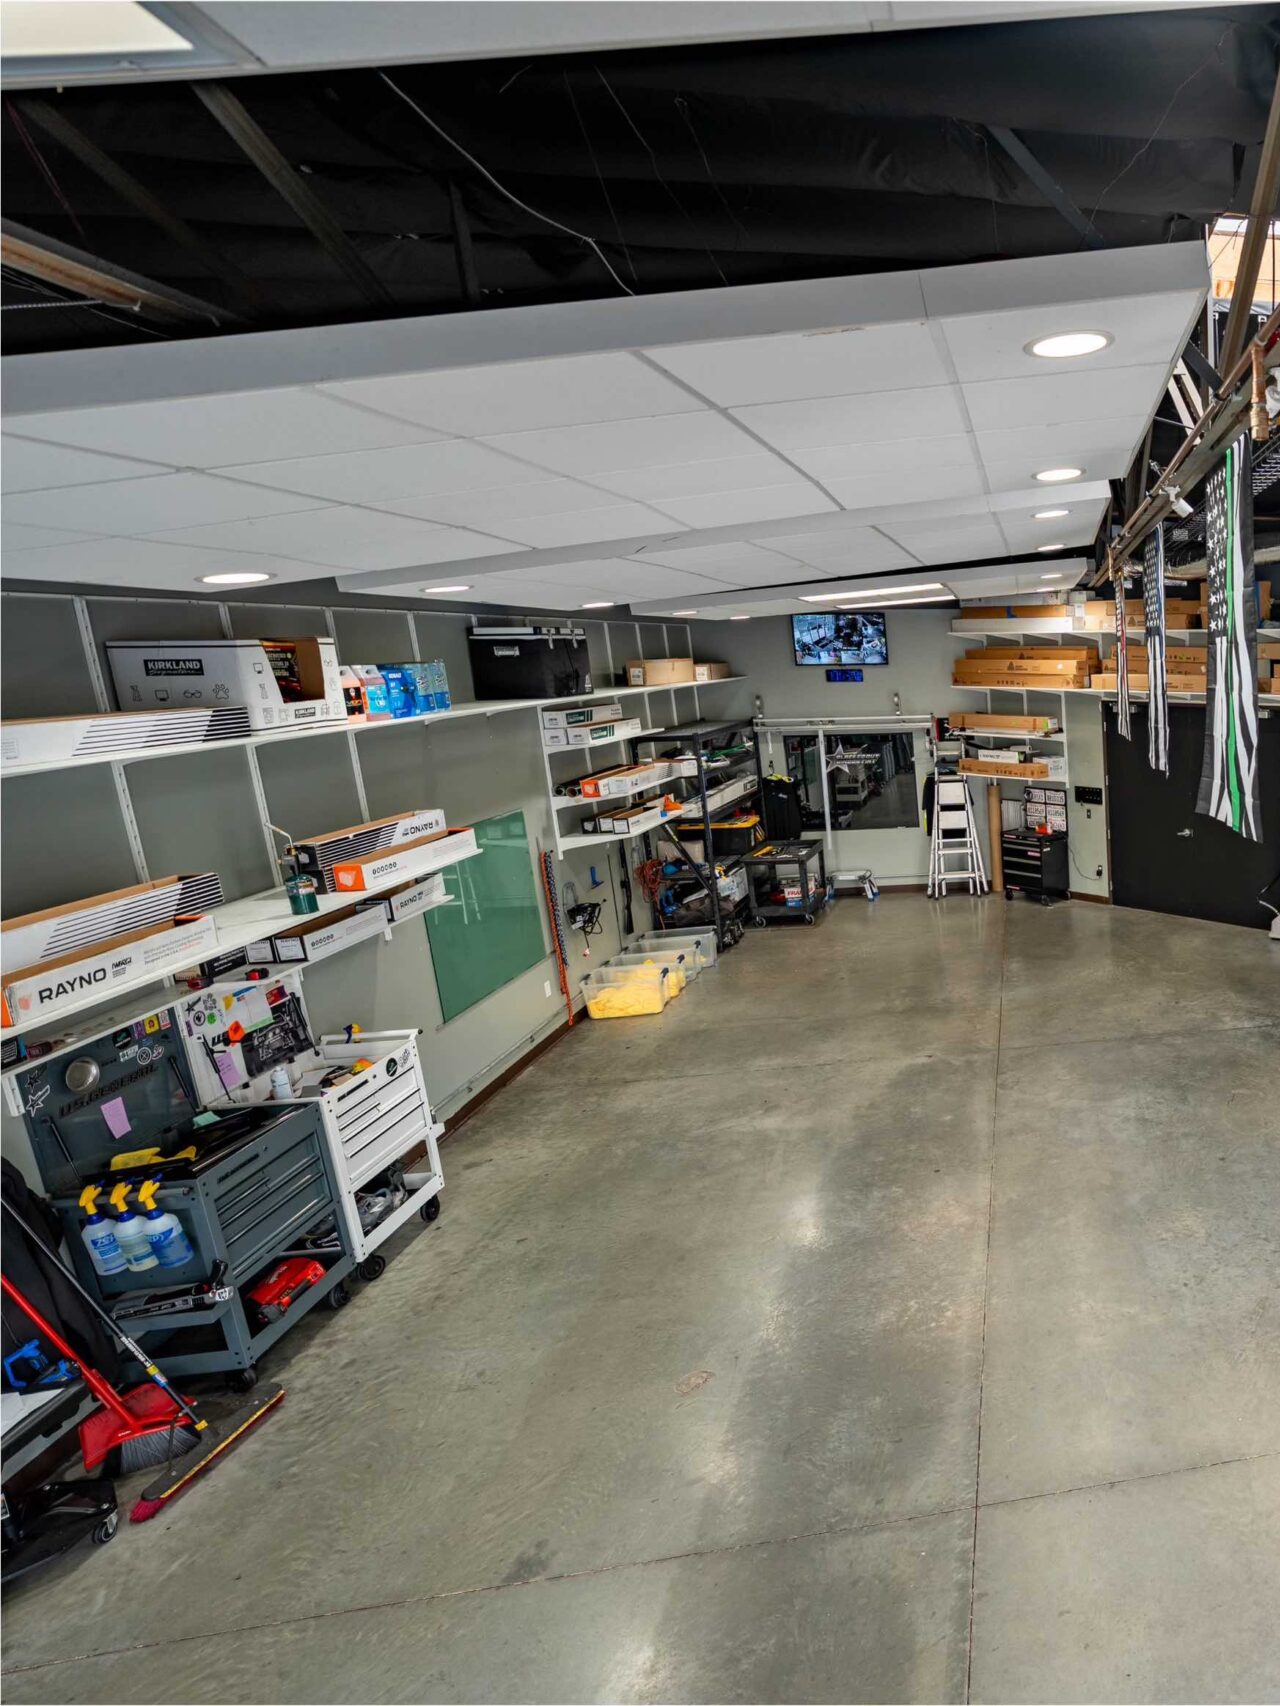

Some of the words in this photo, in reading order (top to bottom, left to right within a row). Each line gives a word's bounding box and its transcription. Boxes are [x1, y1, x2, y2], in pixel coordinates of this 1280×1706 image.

[147, 660, 201, 670] KIRKLAND
[409, 821, 434, 836] RAYNO
[399, 894, 418, 910] RAYNO
[38, 967, 107, 1004] RAYNO
